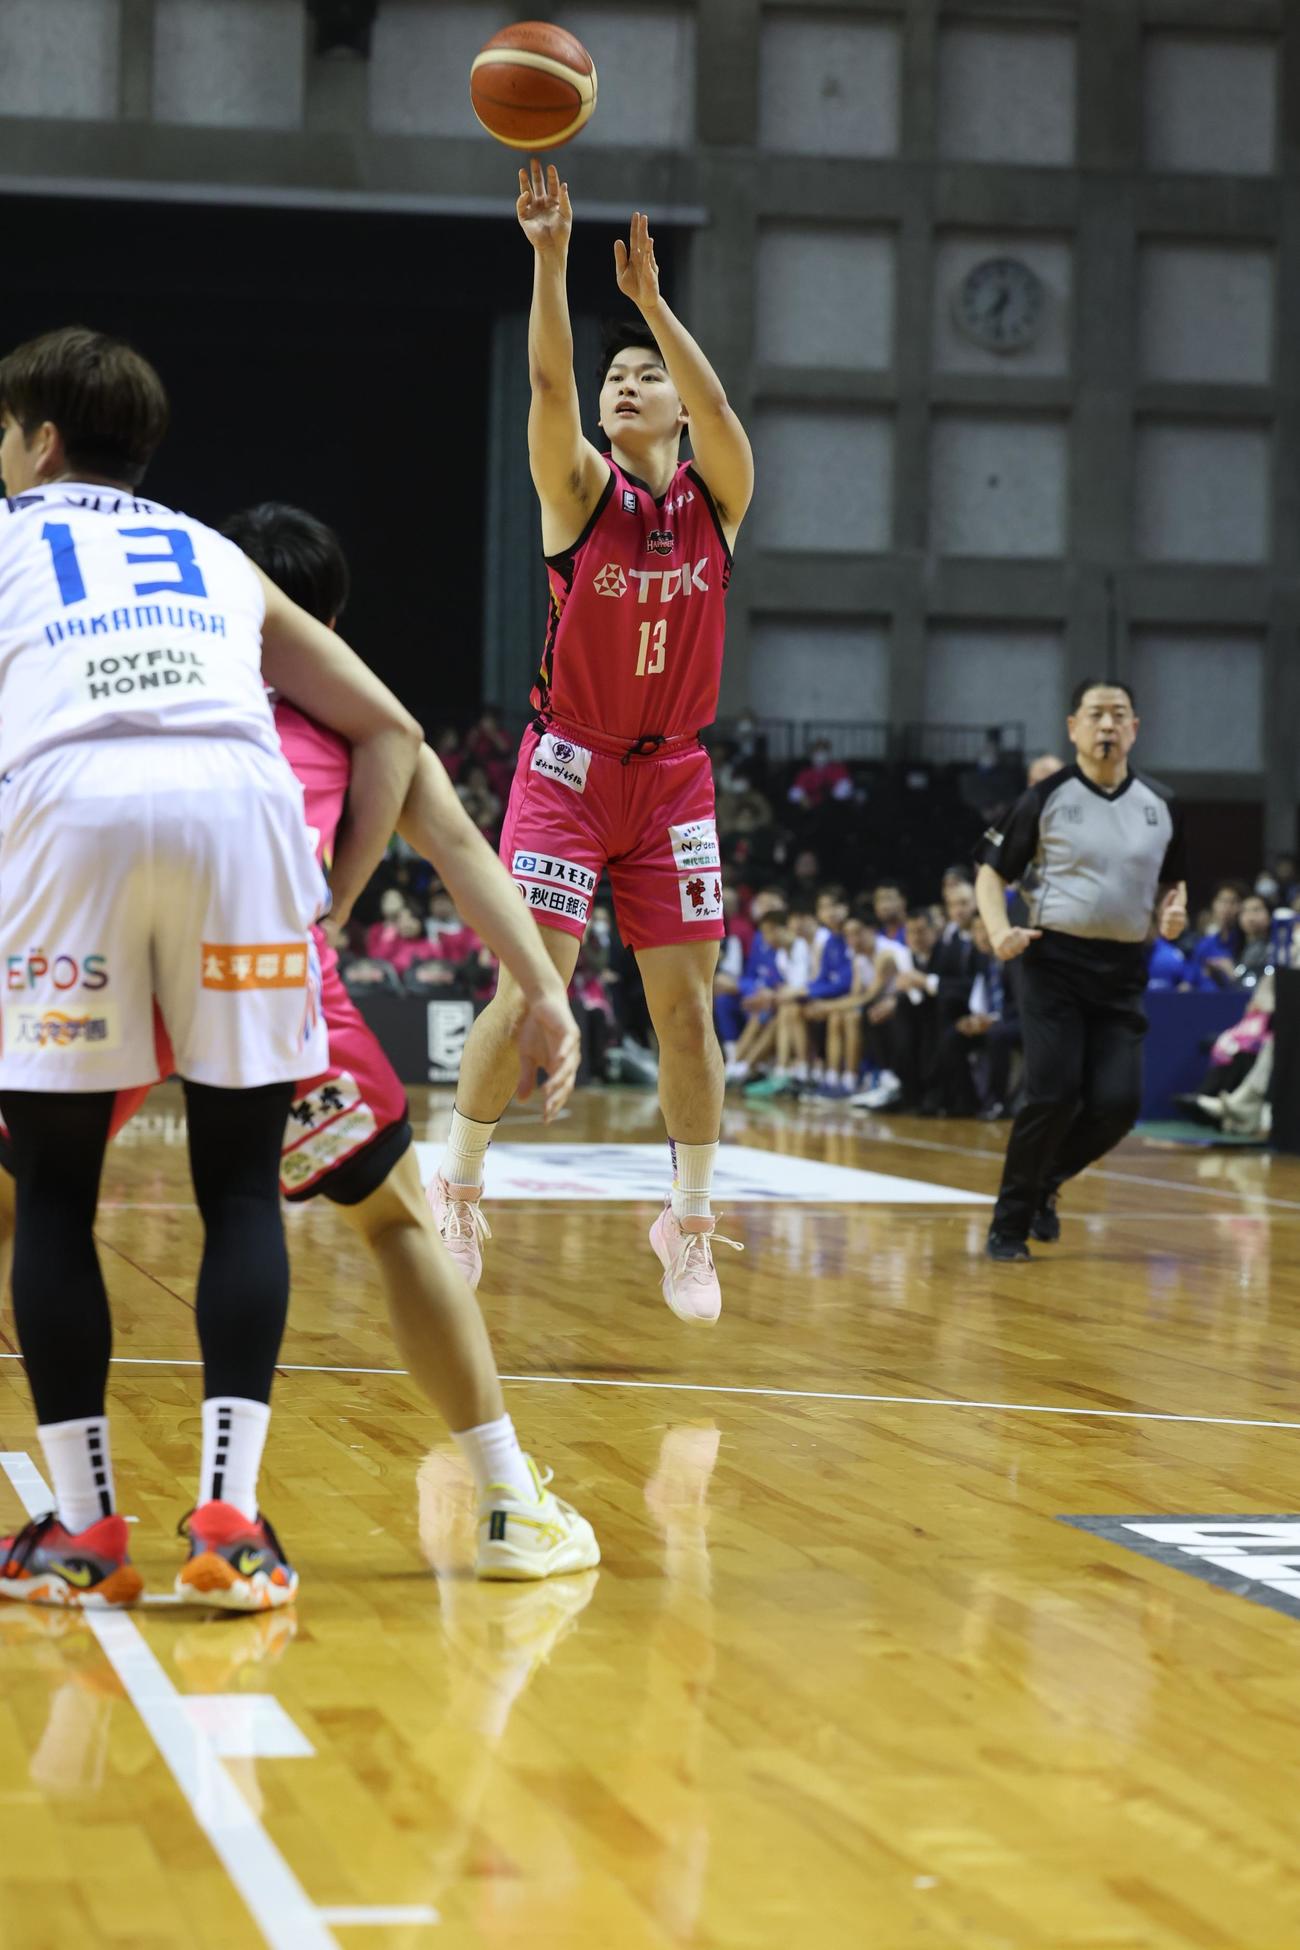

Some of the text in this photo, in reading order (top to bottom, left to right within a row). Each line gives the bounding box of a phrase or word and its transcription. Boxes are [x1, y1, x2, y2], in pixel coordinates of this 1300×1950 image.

[41, 522, 208, 606] 13
[628, 557, 709, 603] TDK
[44, 605, 226, 647] NAKAMURA
[86, 649, 204, 678] JOYFUL
[634, 619, 667, 676] 13
[89, 669, 205, 700] HONDA
[529, 887, 587, 920] 秋田銀行
[7, 954, 109, 990] EPOS
